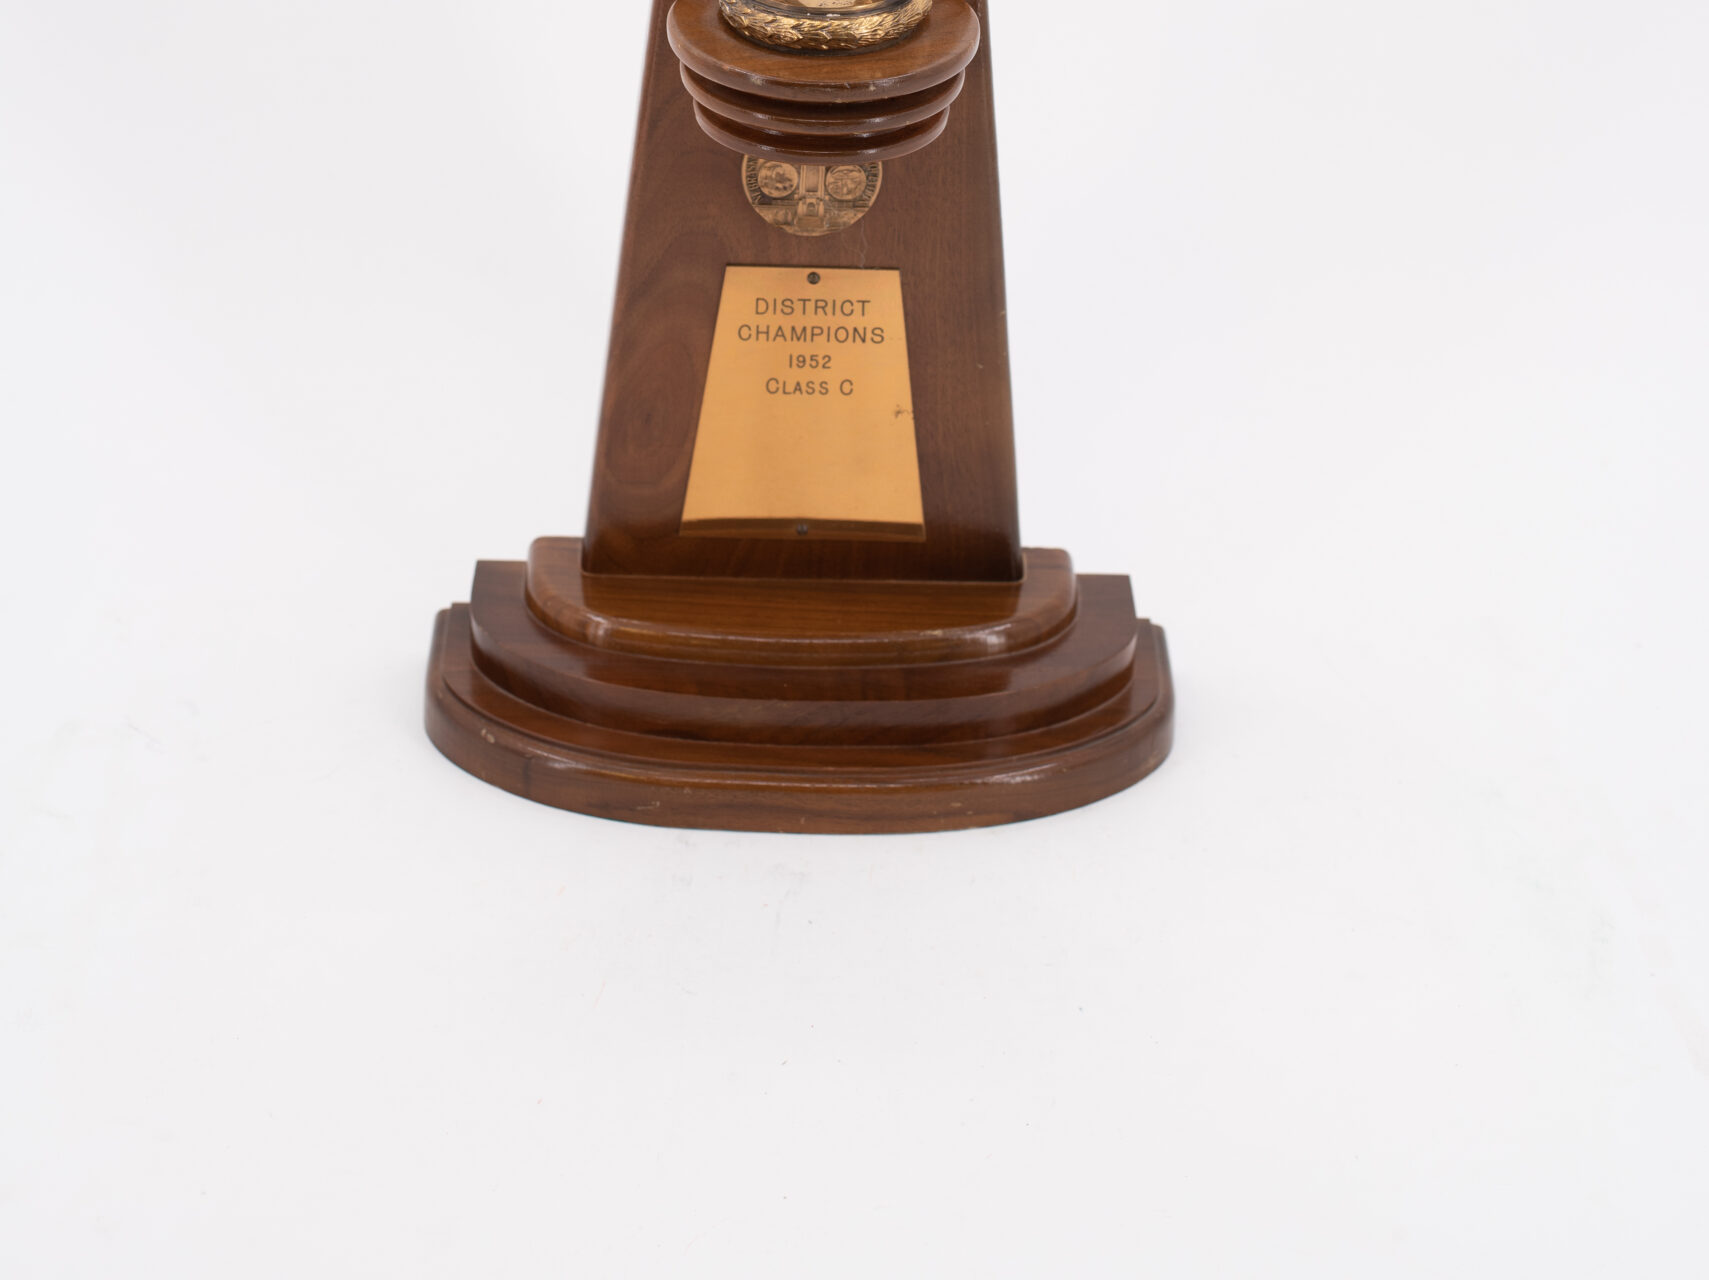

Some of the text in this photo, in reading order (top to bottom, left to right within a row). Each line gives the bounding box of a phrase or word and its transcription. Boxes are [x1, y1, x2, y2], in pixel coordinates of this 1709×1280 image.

[755, 298, 871, 317] DISTRICT
[737, 324, 885, 344] CHAMPIONS
[788, 353, 832, 369] 1952
[765, 377, 854, 396] CLASS C
